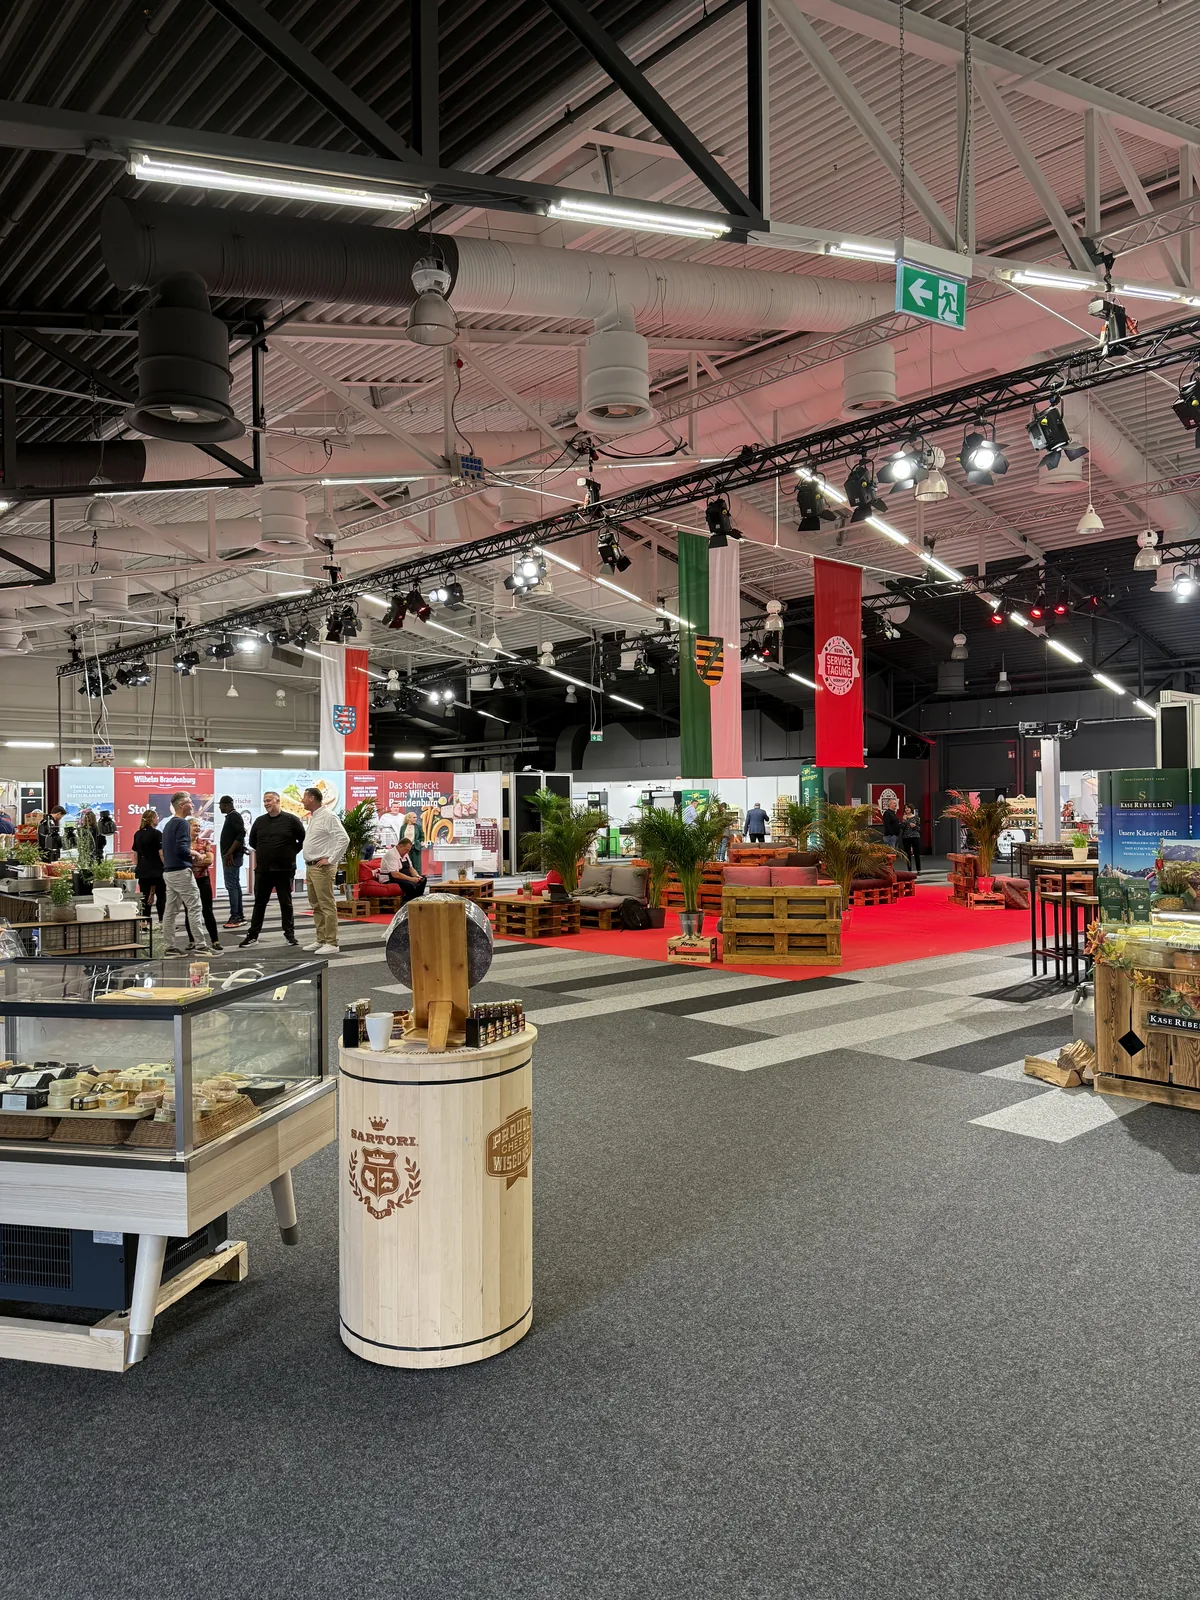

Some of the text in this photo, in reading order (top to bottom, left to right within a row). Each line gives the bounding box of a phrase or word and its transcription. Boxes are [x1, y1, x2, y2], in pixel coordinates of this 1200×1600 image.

[826, 655, 851, 667] SERVICE
[826, 665, 852, 677] TAGUNG
[134, 775, 197, 785] Wilhelm Brandenburg
[389, 780, 440, 790] Das schmeckt
[389, 789, 441, 799] man: Wilhelm
[1136, 829, 1178, 837] Käsevielfalt
[1175, 1018, 1200, 1029] REBE
